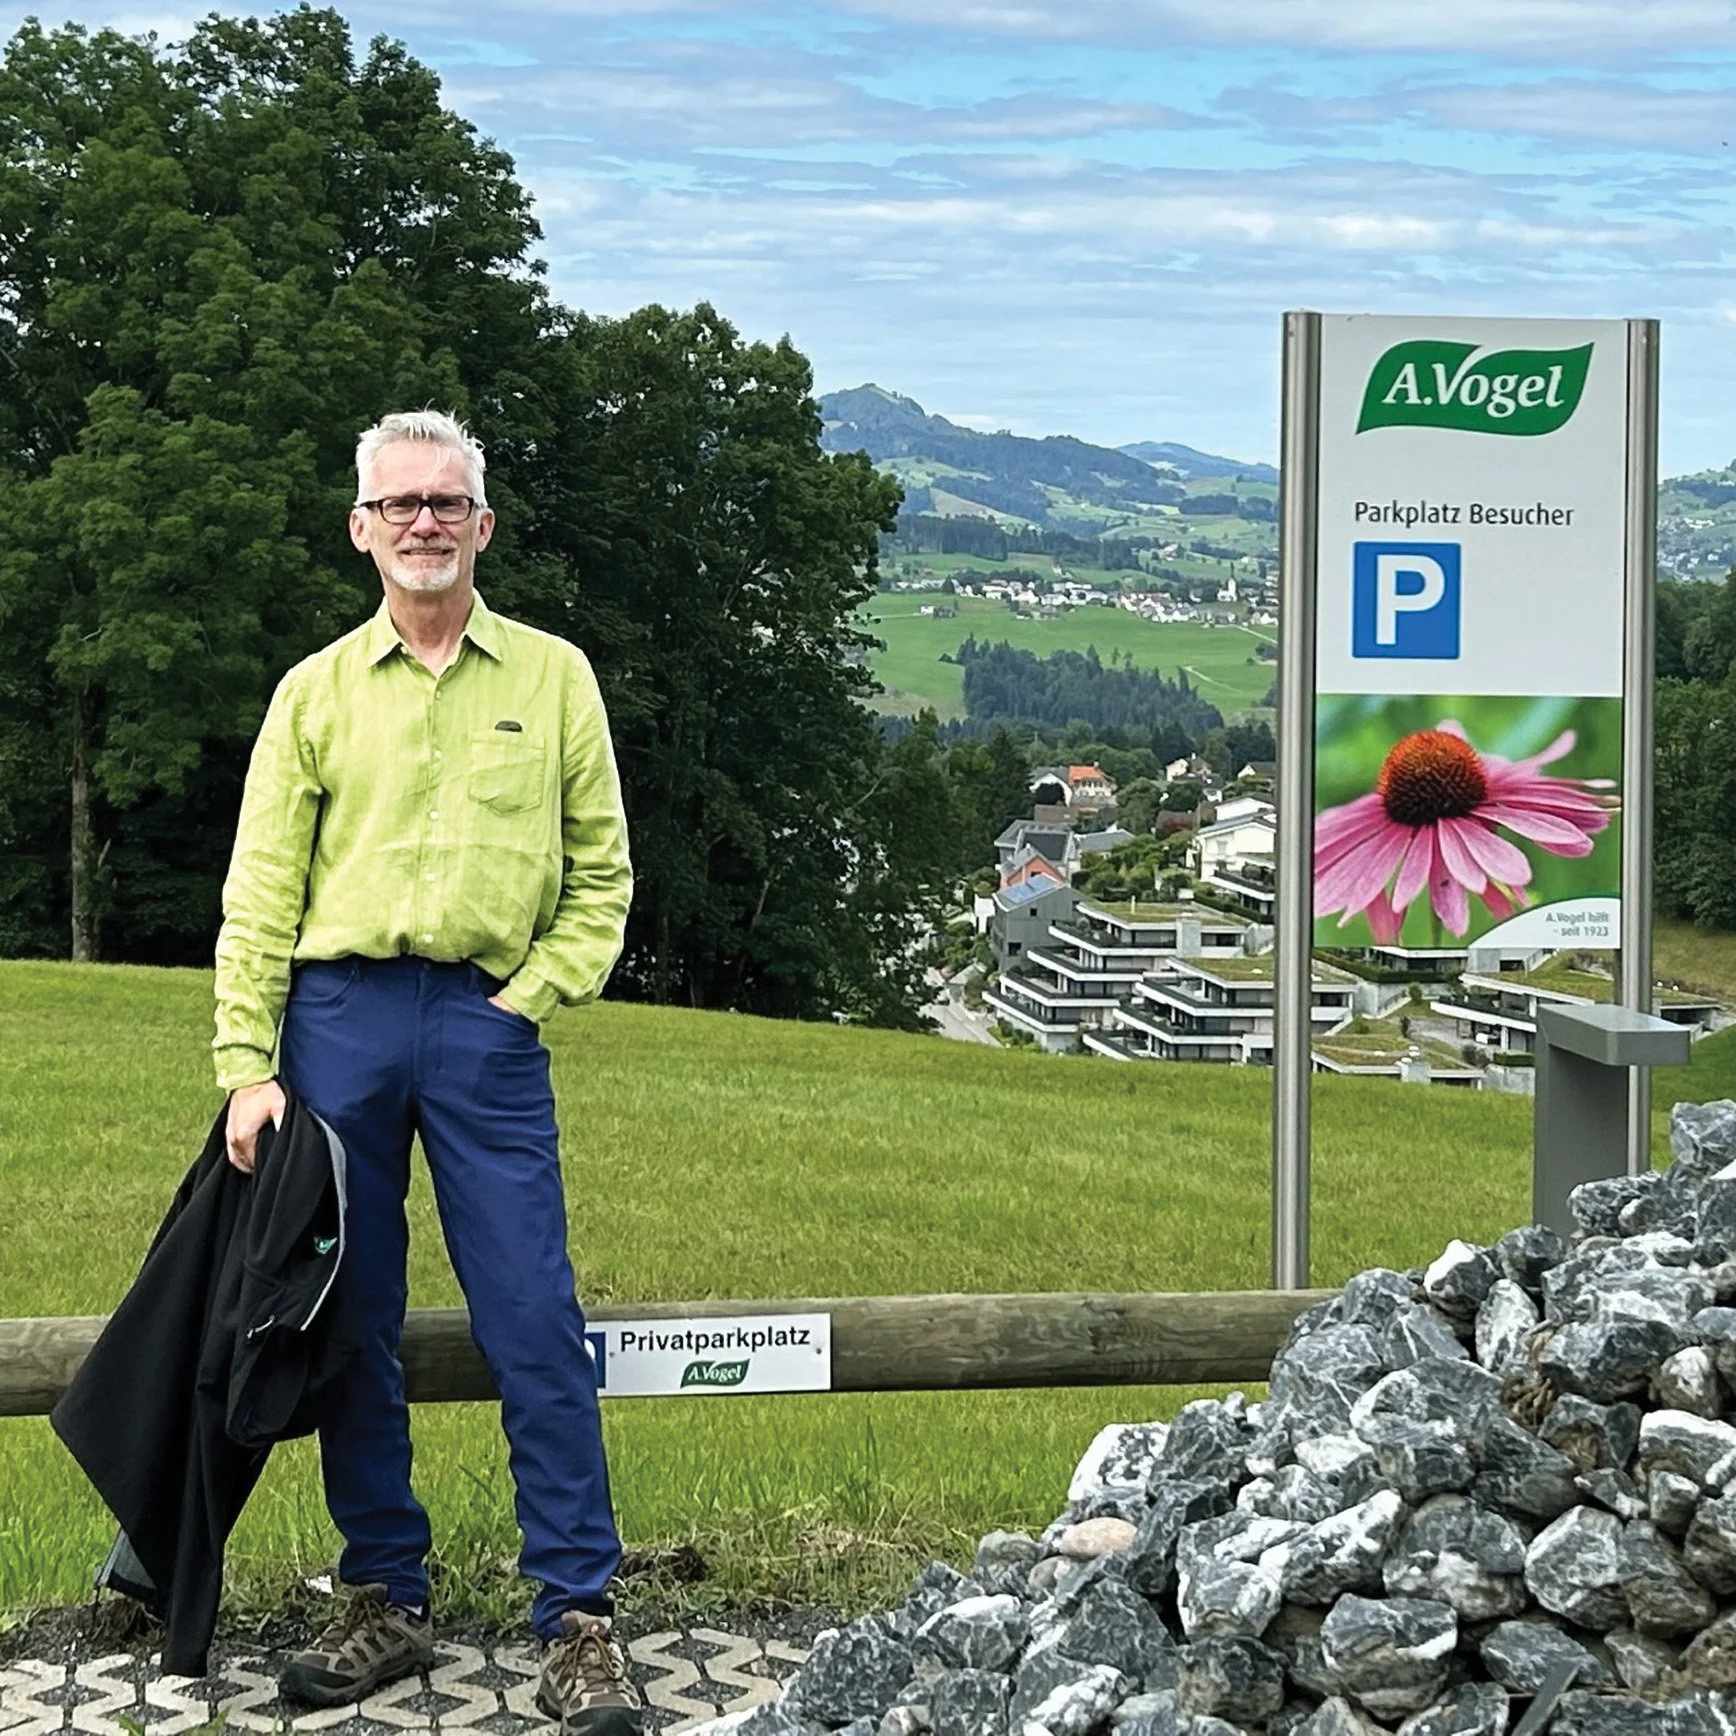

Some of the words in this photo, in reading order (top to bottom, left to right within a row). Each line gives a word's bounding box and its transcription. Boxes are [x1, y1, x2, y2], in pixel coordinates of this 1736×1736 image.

[1381, 362, 1565, 418] A.Vogel
[1355, 500, 1462, 528] Parkplatz
[1469, 503, 1575, 527] Besucher
[1376, 554, 1446, 645] P
[1561, 926, 1580, 937] seit
[1584, 926, 1609, 937] 1923
[620, 1326, 811, 1355] Privatparkplatz
